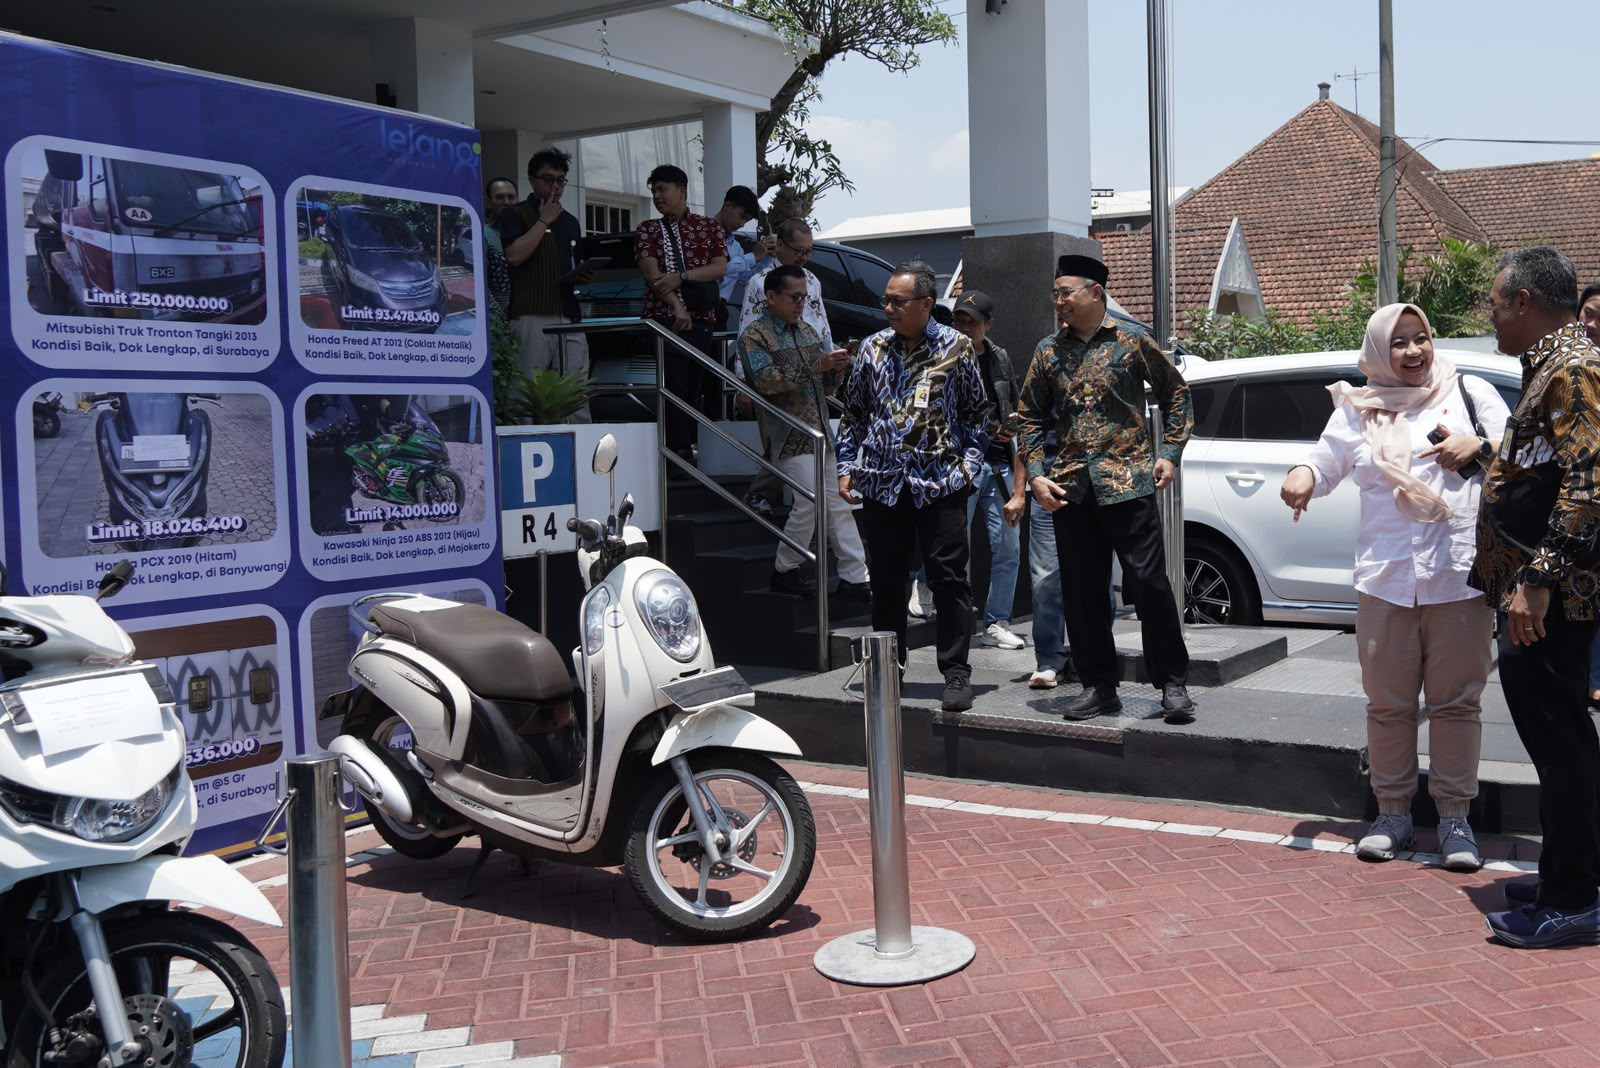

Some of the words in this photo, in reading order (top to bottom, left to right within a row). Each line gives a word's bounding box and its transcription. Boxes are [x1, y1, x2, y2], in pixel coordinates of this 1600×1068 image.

[83, 289, 128, 305] Limit
[132, 294, 229, 310] 250.000.000
[341, 306, 374, 321] Limit
[376, 308, 439, 323] 93.478.400
[46, 322, 115, 337] Mitsubishi
[117, 325, 143, 337] Truk
[147, 327, 192, 338] Tronton
[195, 329, 233, 342] Tangki
[235, 331, 257, 342] 2013
[308, 334, 340, 346] Honda
[343, 336, 369, 346] Freed
[371, 337, 382, 347] AT
[384, 338, 402, 348] 2012
[404, 337, 436, 349] (Coklat
[438, 339, 472, 351] Metalik)
[32, 338, 81, 352] Kondisi
[85, 340, 116, 354] Baik,
[119, 342, 143, 354] Dok
[146, 343, 200, 357] Lengkap,
[203, 344, 213, 356] di
[216, 346, 269, 358] Surabaya
[305, 350, 341, 360] Kondisi
[343, 351, 366, 361] Baik,
[368, 351, 386, 361] Dok
[389, 351, 429, 363] Lengkap,
[430, 352, 439, 362] di
[441, 353, 475, 365] Sidoarjo
[521, 441, 554, 503] P
[346, 507, 384, 522] Limit
[386, 503, 457, 518] 14.000.000
[88, 522, 139, 540] Limit
[143, 516, 243, 536] 18.026.400
[522, 514, 536, 543] R
[544, 512, 557, 540] 4
[324, 539, 370, 551] Kawasaki
[372, 537, 395, 549] Ninja
[399, 535, 414, 545] 250
[415, 533, 432, 542] ABS
[434, 531, 451, 541] 2012
[453, 528, 480, 541] (Hijau)
[96, 559, 137, 572] Hoa
[141, 554, 166, 567] PCX
[168, 553, 192, 566] 2019
[195, 550, 237, 564] (Hitam)
[312, 555, 349, 567] Kondisi
[351, 553, 374, 564] Baik,
[376, 550, 394, 561] Dok
[396, 548, 436, 560] Lengkap,
[438, 545, 446, 555] di
[448, 541, 490, 555] Mojokerto
[33, 580, 83, 595] Kondisi
[130, 576, 145, 586] ok
[149, 568, 203, 584] Lengkap,
[206, 566, 216, 578] di
[219, 561, 287, 578] Banyuwangi
[232, 773, 246, 783] Gr
[207, 794, 218, 805] di
[221, 783, 276, 802] Surabaya
